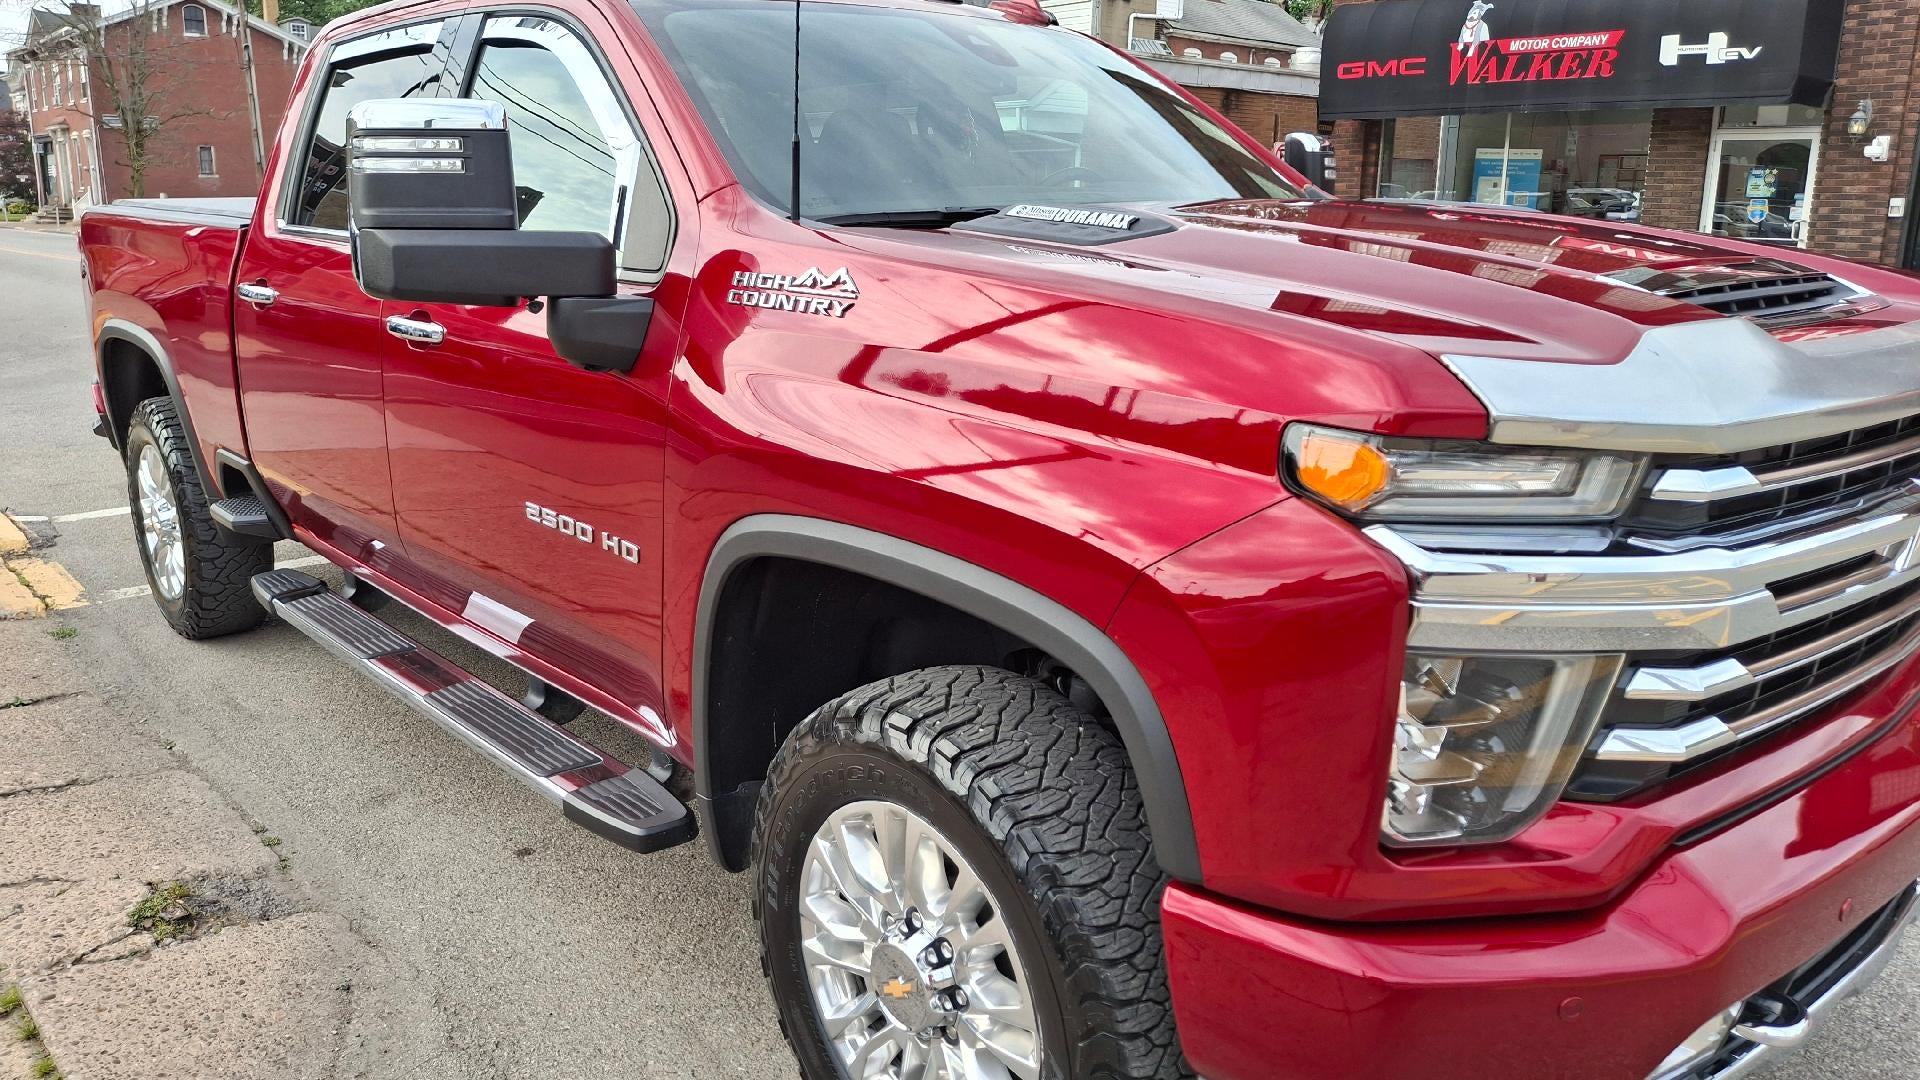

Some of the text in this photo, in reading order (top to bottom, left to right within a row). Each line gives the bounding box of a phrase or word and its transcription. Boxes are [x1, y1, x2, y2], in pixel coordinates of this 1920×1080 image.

[1509, 33, 1609, 51] MOTOR COMPANY
[1337, 57, 1427, 79] GMC
[1450, 39, 1618, 85] WALKER
[1053, 208, 1137, 230] DURAMAX
[732, 271, 793, 290] HIGH
[727, 289, 855, 318] COUNTRY
[525, 501, 640, 564] 2500 HD
